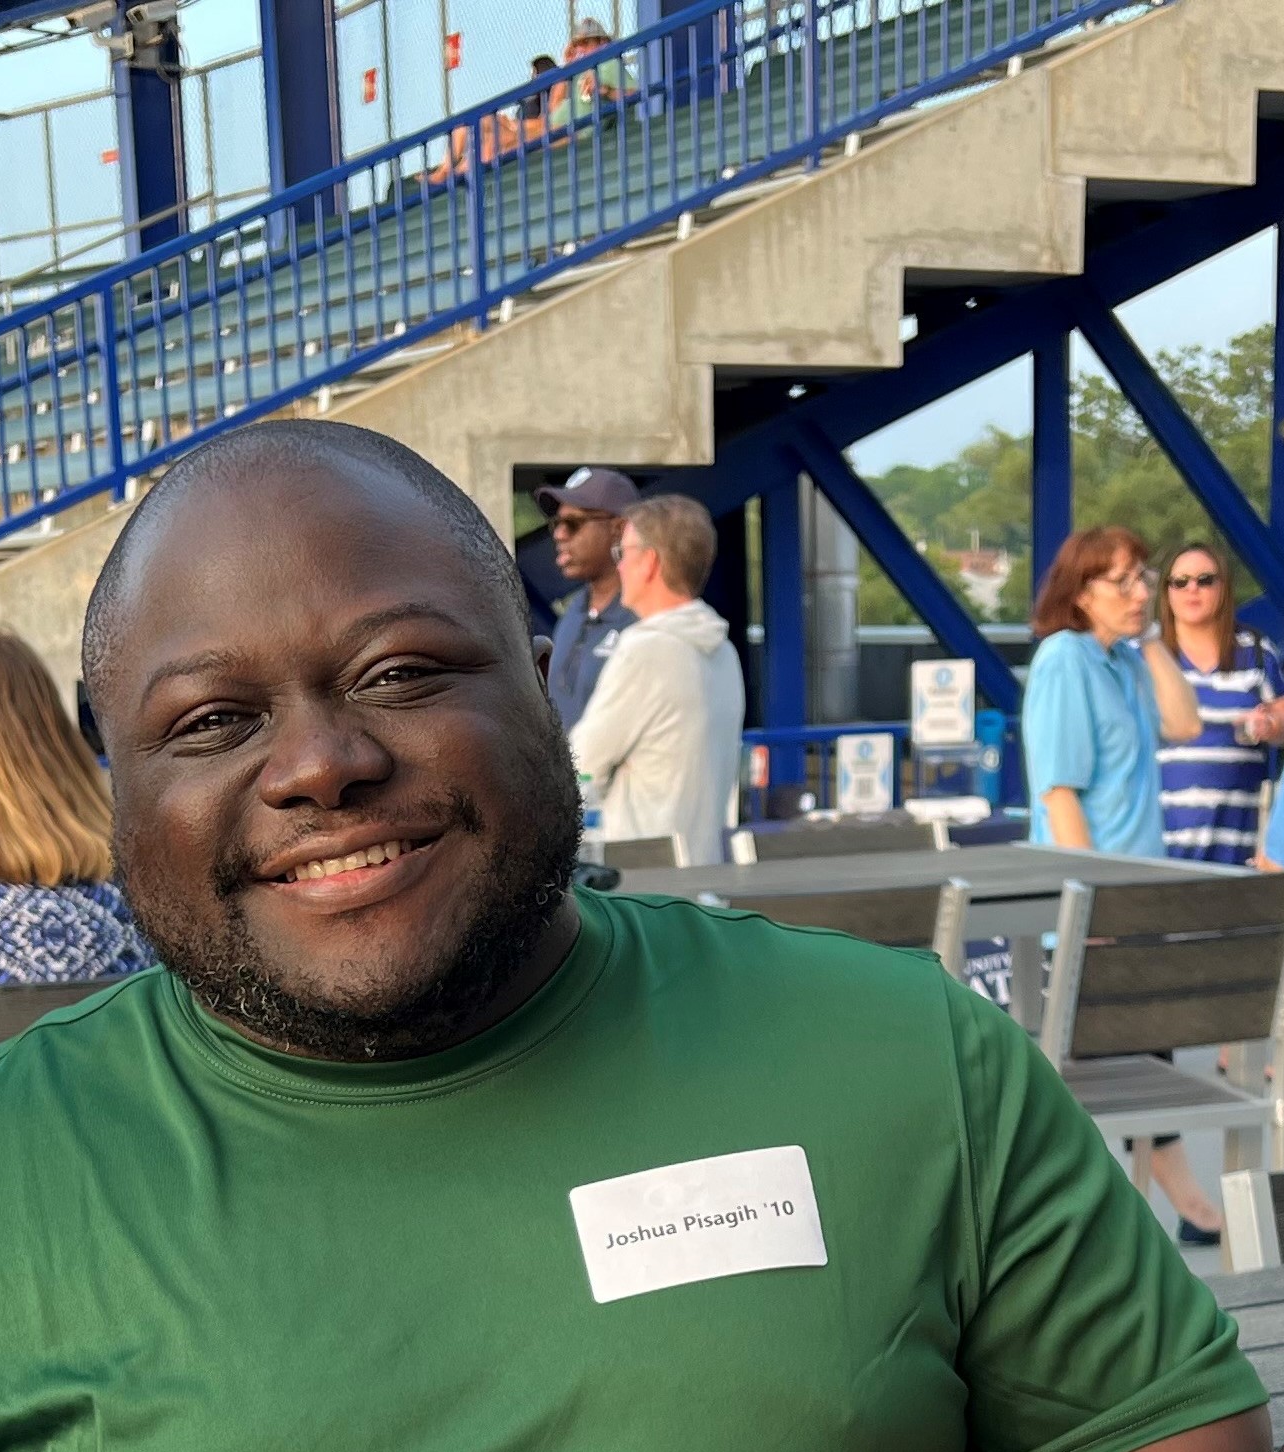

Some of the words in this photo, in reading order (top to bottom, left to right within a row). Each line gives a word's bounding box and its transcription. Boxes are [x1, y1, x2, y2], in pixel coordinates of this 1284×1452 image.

[605, 1222, 678, 1250] Joshua
[682, 1205, 759, 1232] Pisagih
[763, 1199, 795, 1218] '10
